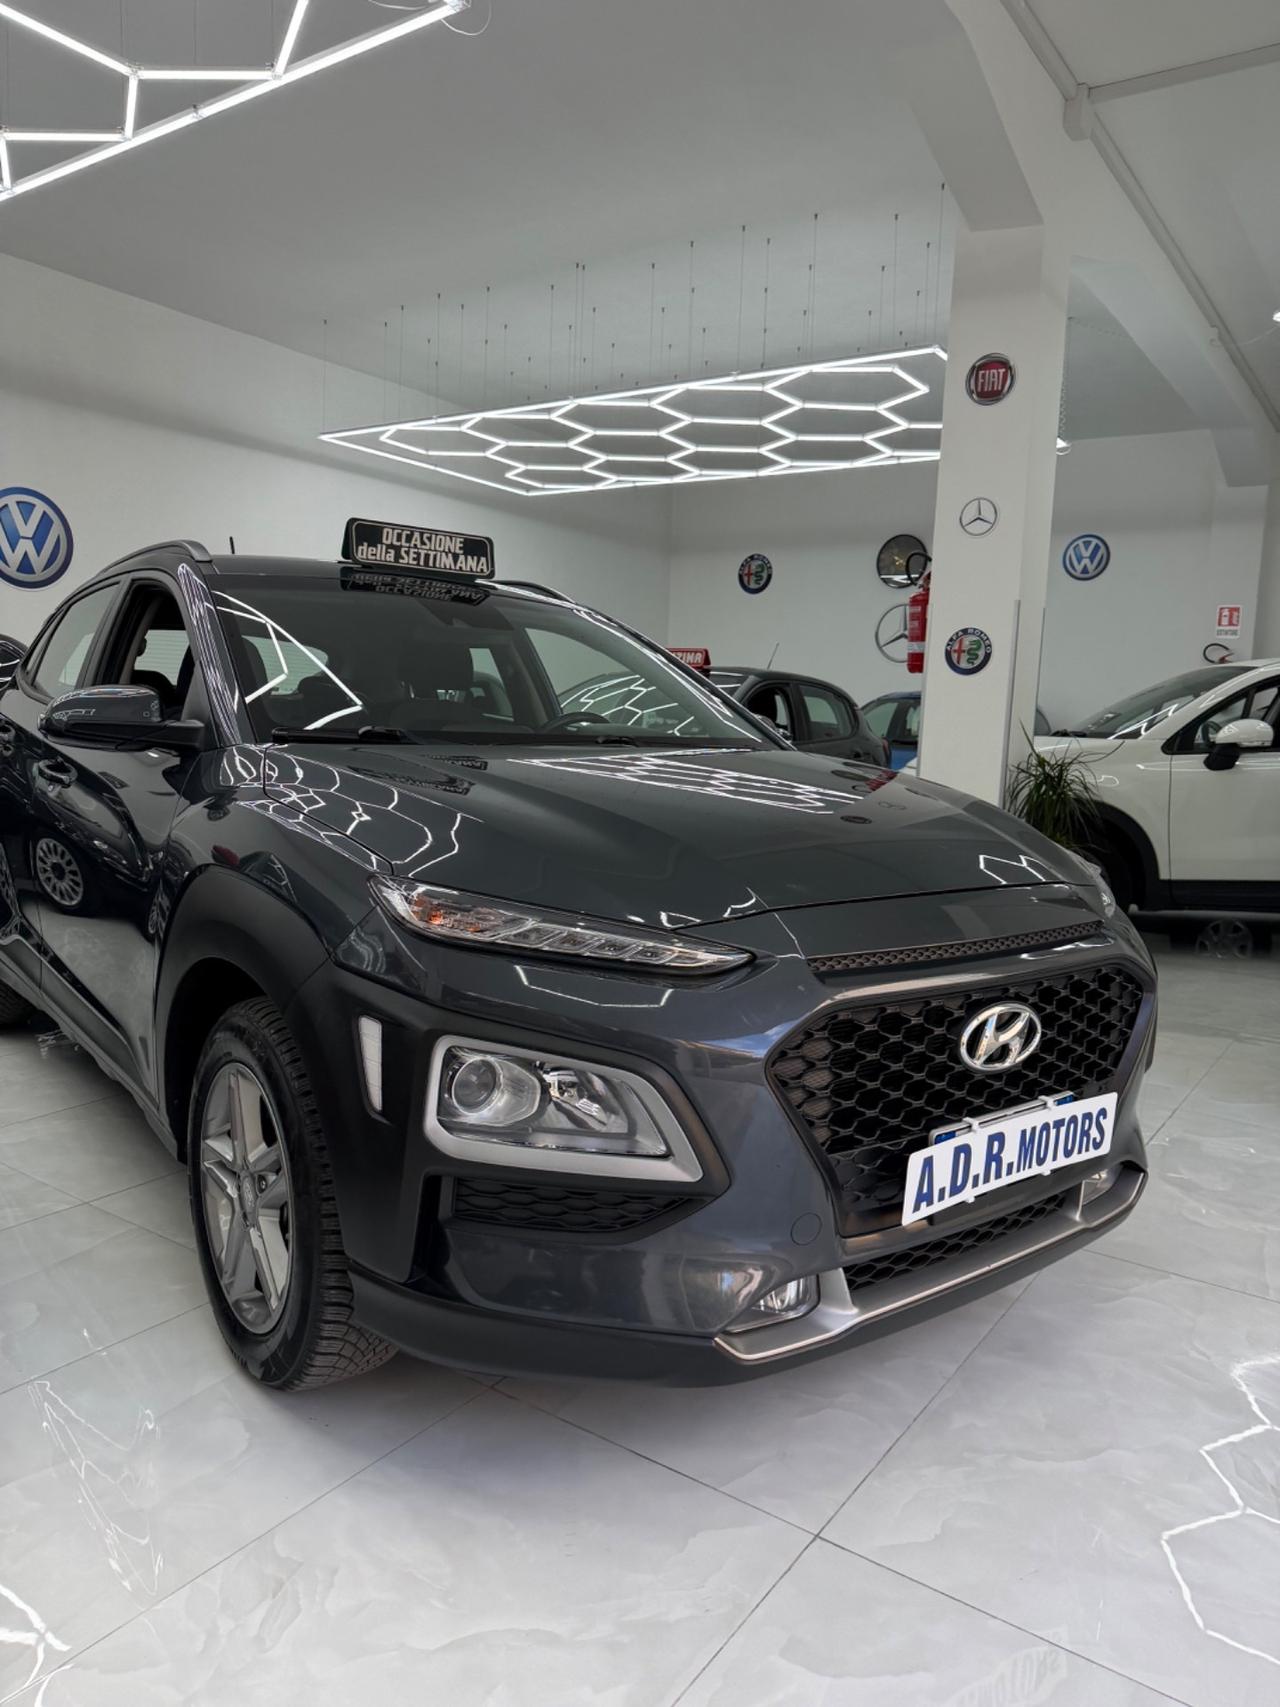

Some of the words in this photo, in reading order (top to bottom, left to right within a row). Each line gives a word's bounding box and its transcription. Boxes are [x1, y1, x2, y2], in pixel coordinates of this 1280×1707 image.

[976, 367, 1007, 393] FIAT
[382, 527, 465, 554] OCCASIONE
[357, 542, 395, 563] della
[398, 547, 488, 573] SETTIMANA
[946, 631, 964, 652] ALFA
[967, 628, 992, 654] ROMEO
